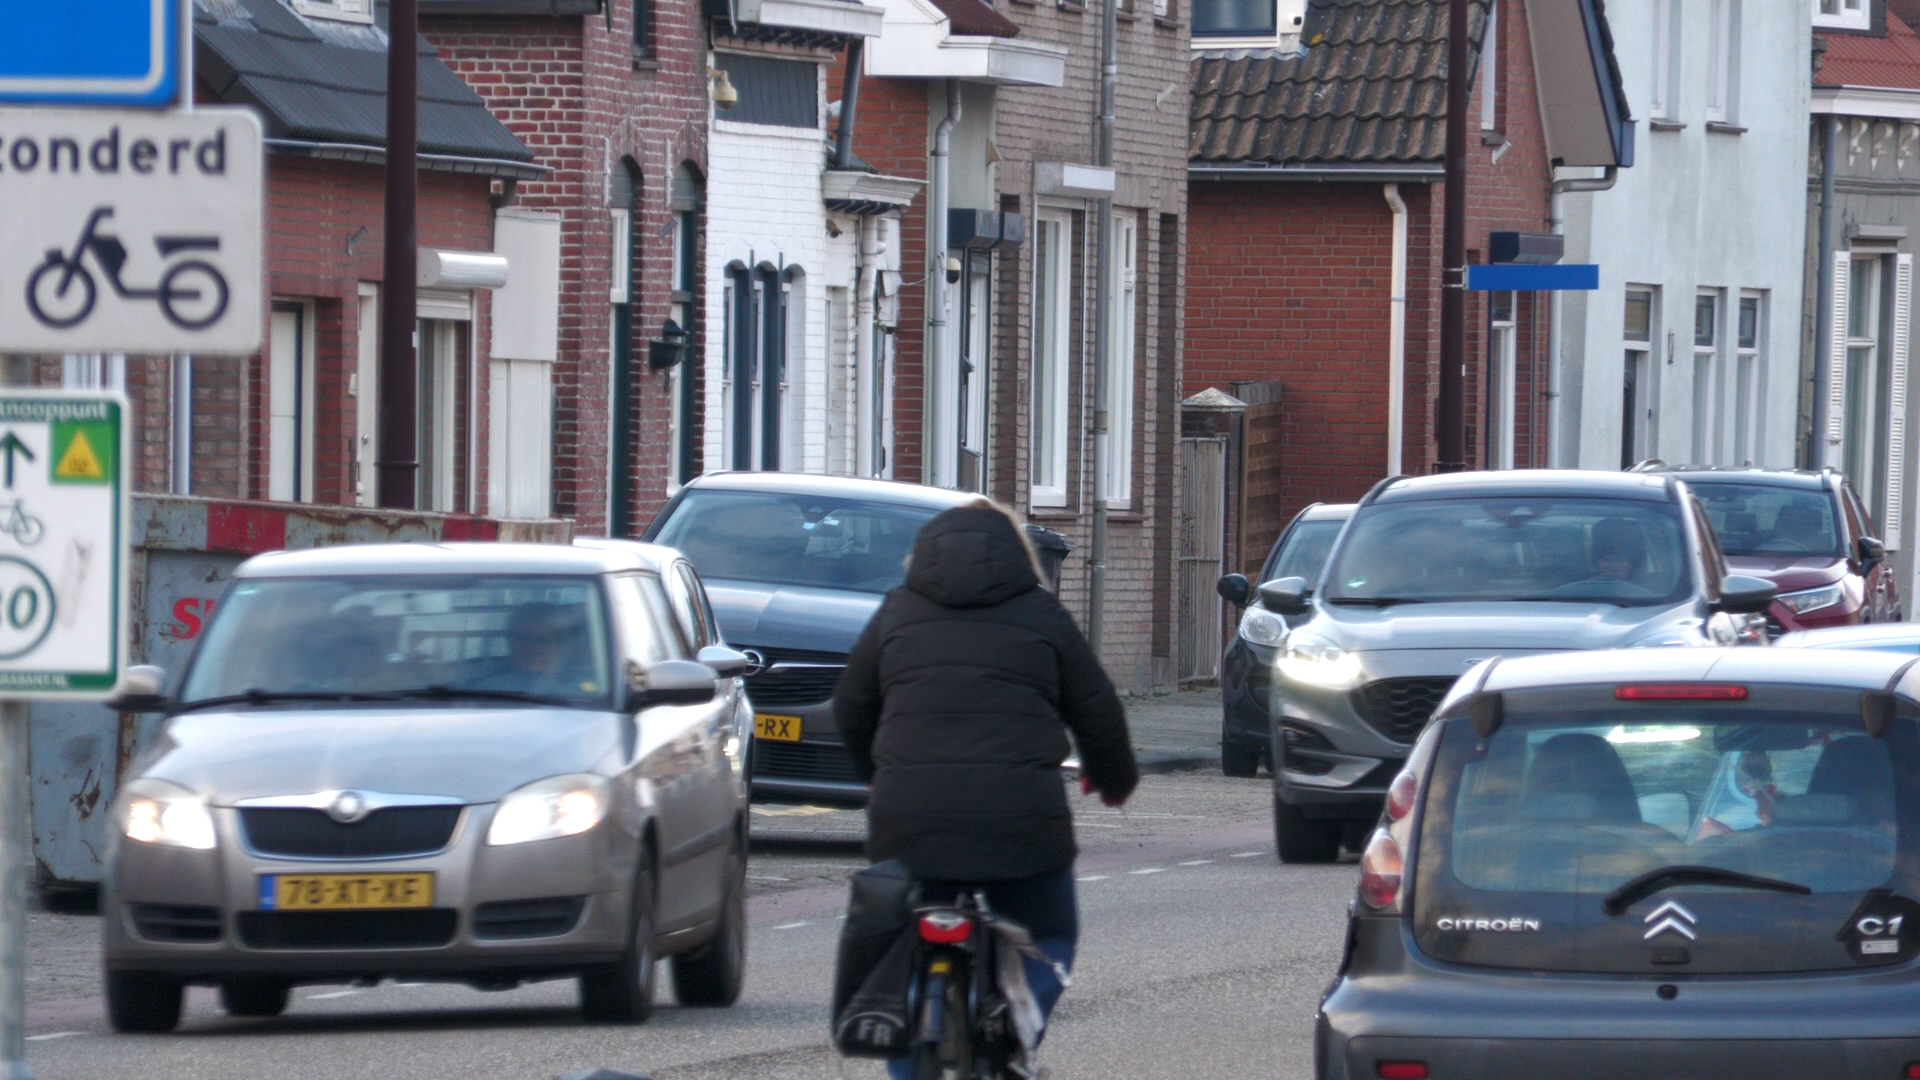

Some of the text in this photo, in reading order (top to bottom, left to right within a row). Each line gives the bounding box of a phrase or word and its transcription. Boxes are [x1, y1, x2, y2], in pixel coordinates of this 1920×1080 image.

[0, 126, 227, 176] onderd
[0, 585, 38, 630] 0
[284, 878, 418, 905] 78-XT-XF
[1436, 917, 1539, 931] CITROËN
[1857, 915, 1904, 936] C1
[858, 1019, 893, 1046] FR
